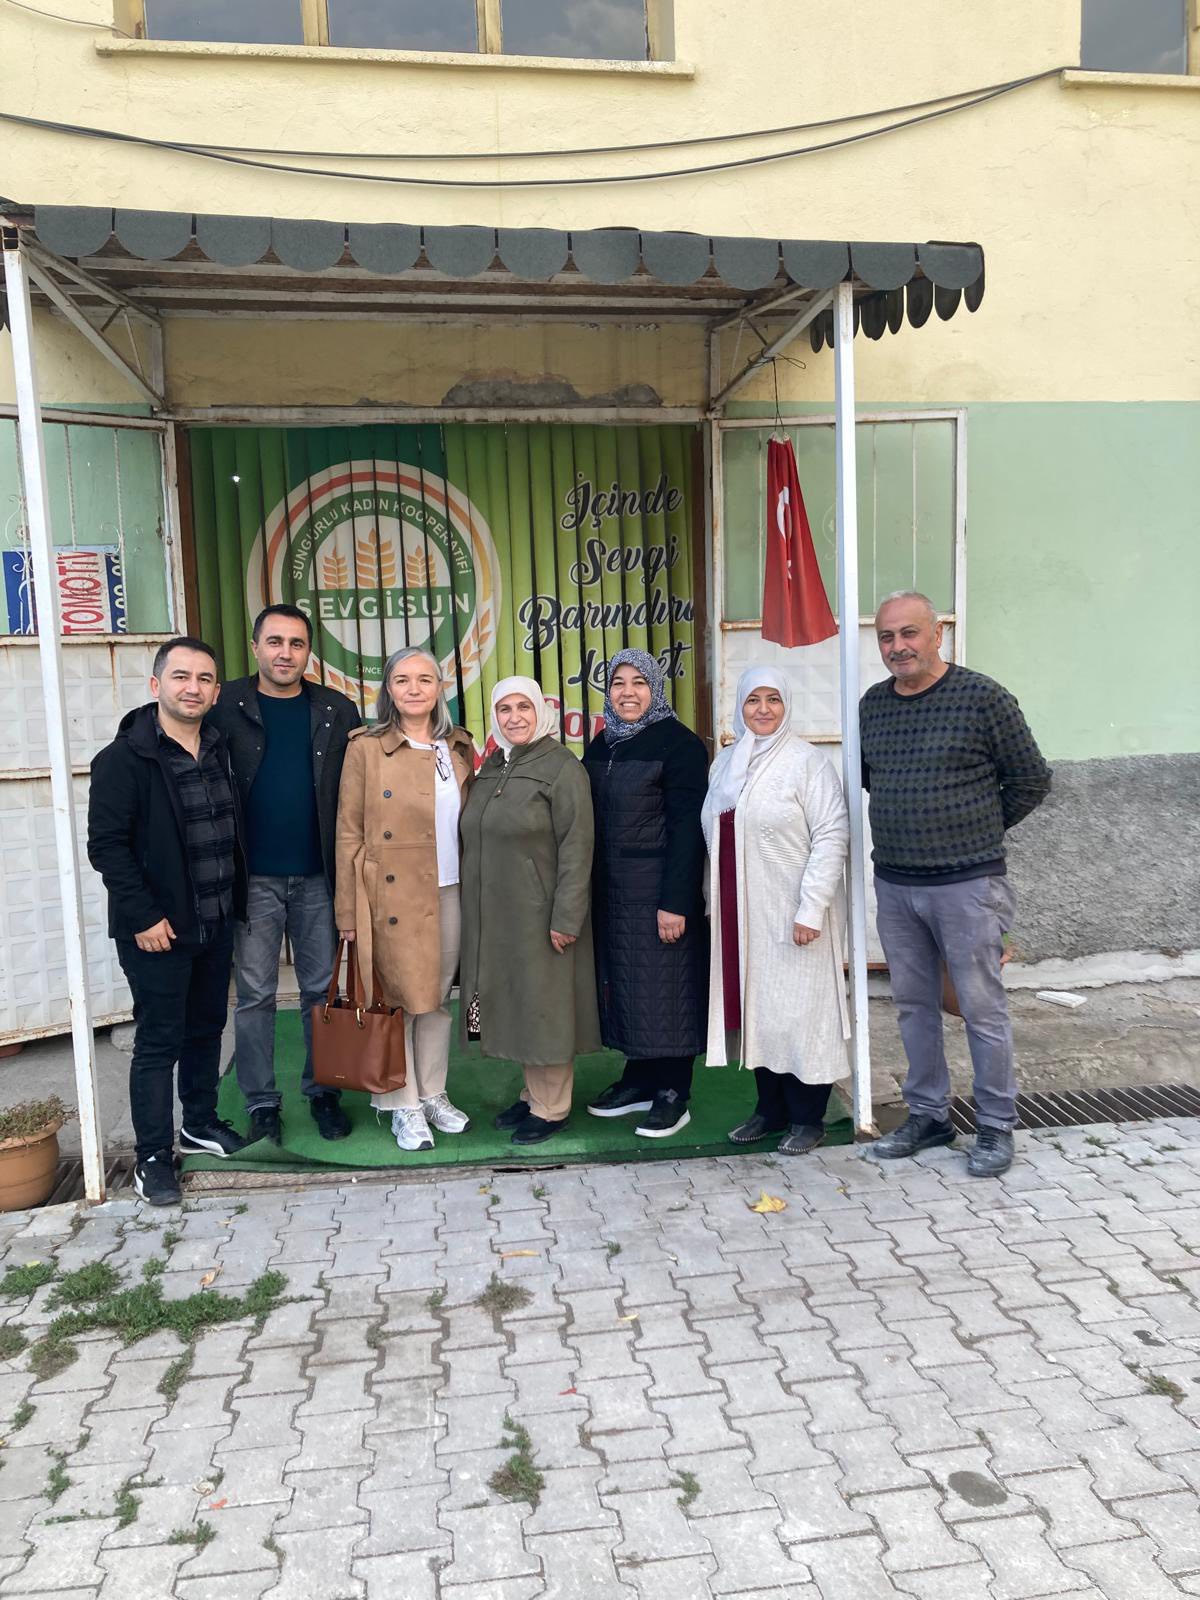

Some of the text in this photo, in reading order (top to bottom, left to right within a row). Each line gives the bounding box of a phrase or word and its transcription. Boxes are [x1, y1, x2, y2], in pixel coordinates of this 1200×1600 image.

[562, 472, 682, 529] İçinde
[292, 498, 472, 580] SUNGURLU KADIN KOOPERATİFİ
[571, 536, 679, 585] Sevgi
[295, 590, 470, 618] SEVGİSUN
[568, 641, 691, 693] Leet.
